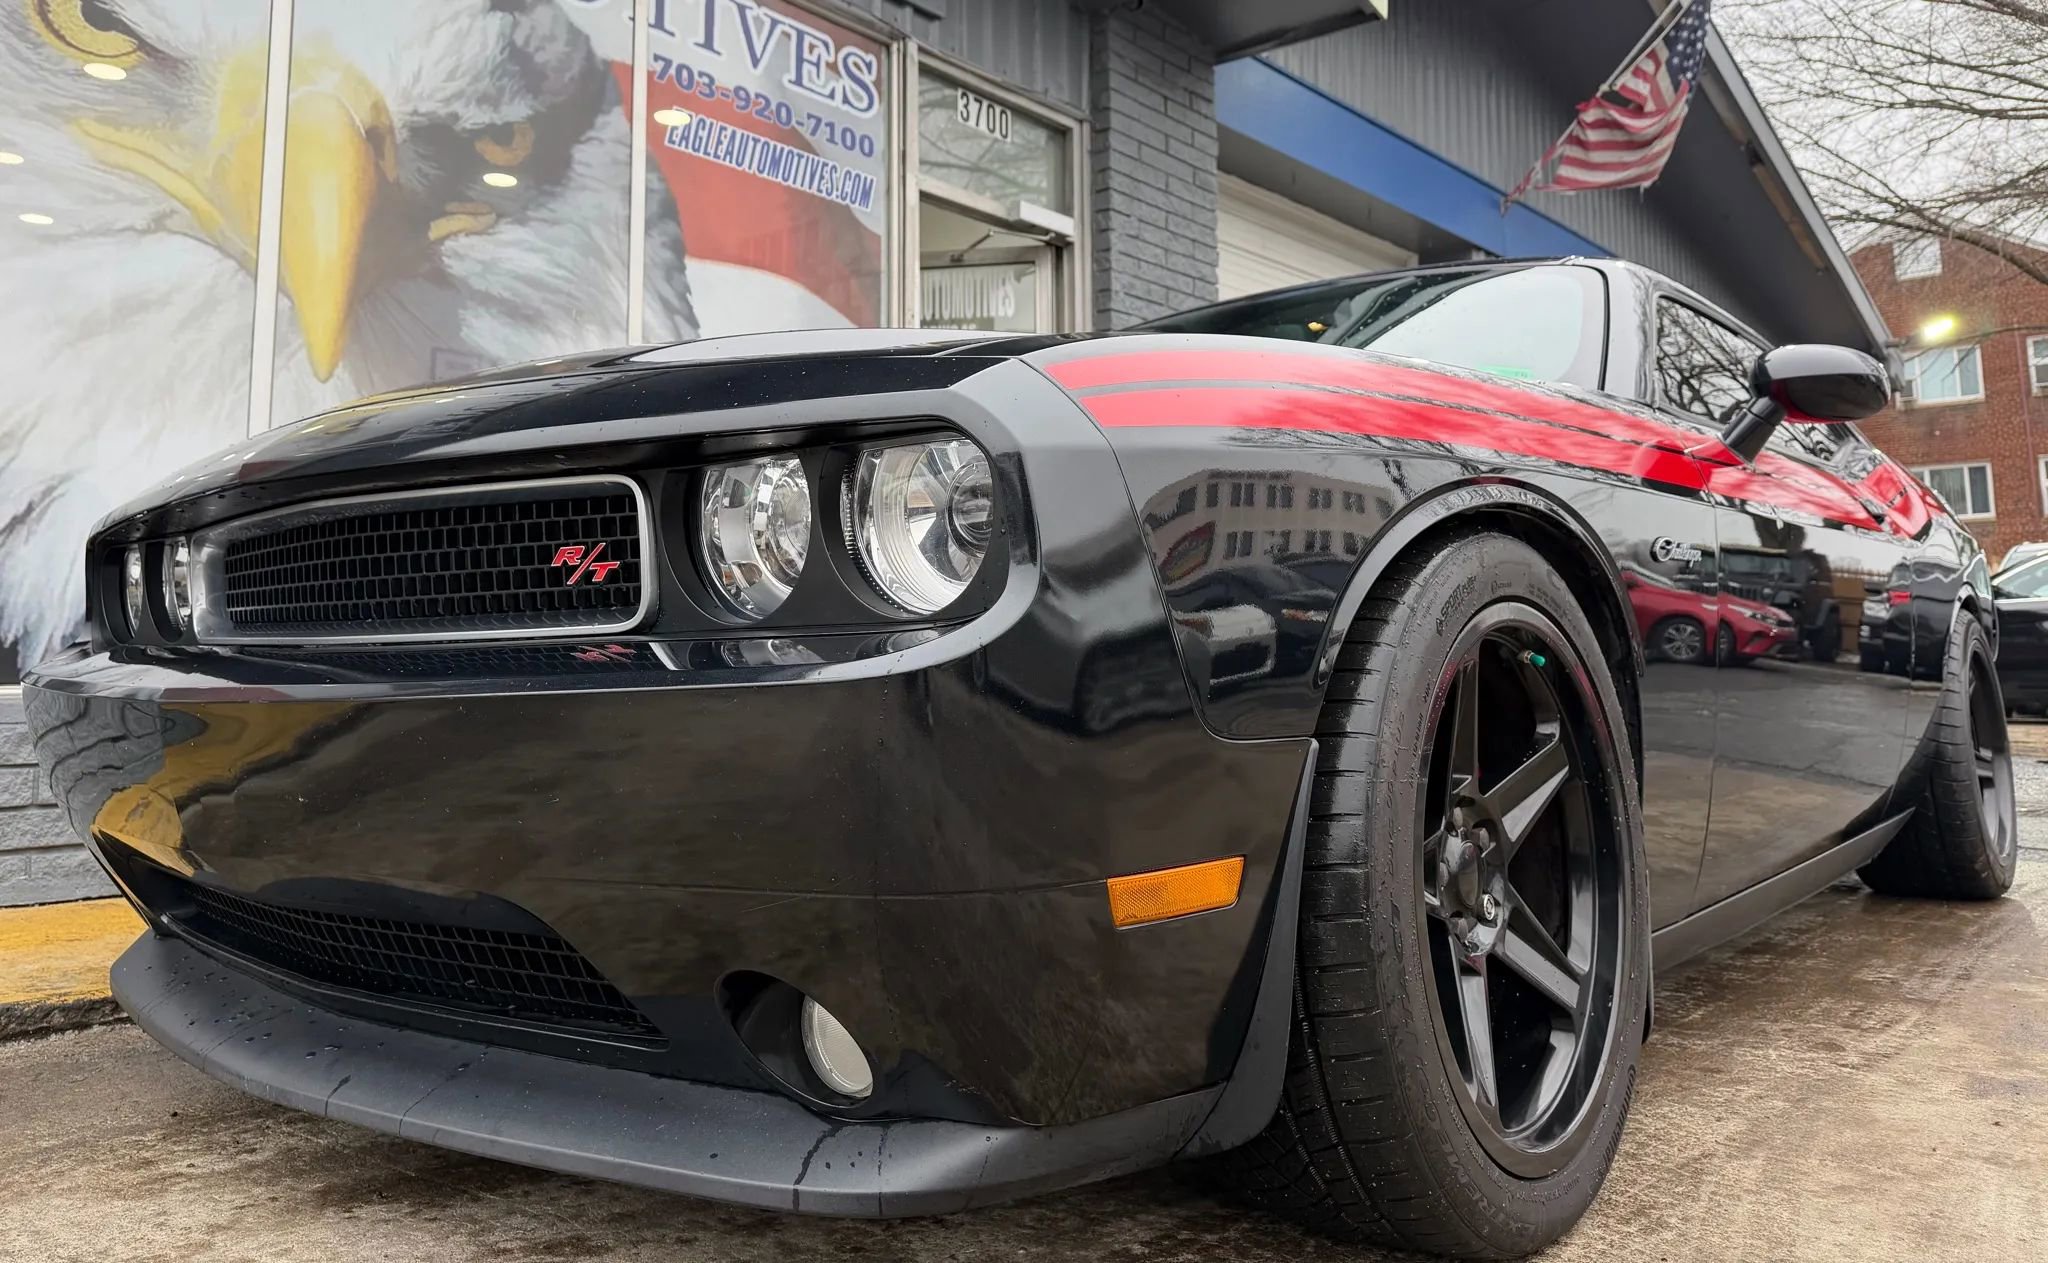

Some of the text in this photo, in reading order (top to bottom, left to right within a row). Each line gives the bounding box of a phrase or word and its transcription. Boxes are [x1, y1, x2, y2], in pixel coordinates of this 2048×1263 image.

[653, 53, 875, 158] 703-920-7100
[960, 91, 1008, 139] 3700
[667, 108, 875, 210] EAGLEAUTOMOTIVES.COM
[551, 542, 621, 585] R/T
